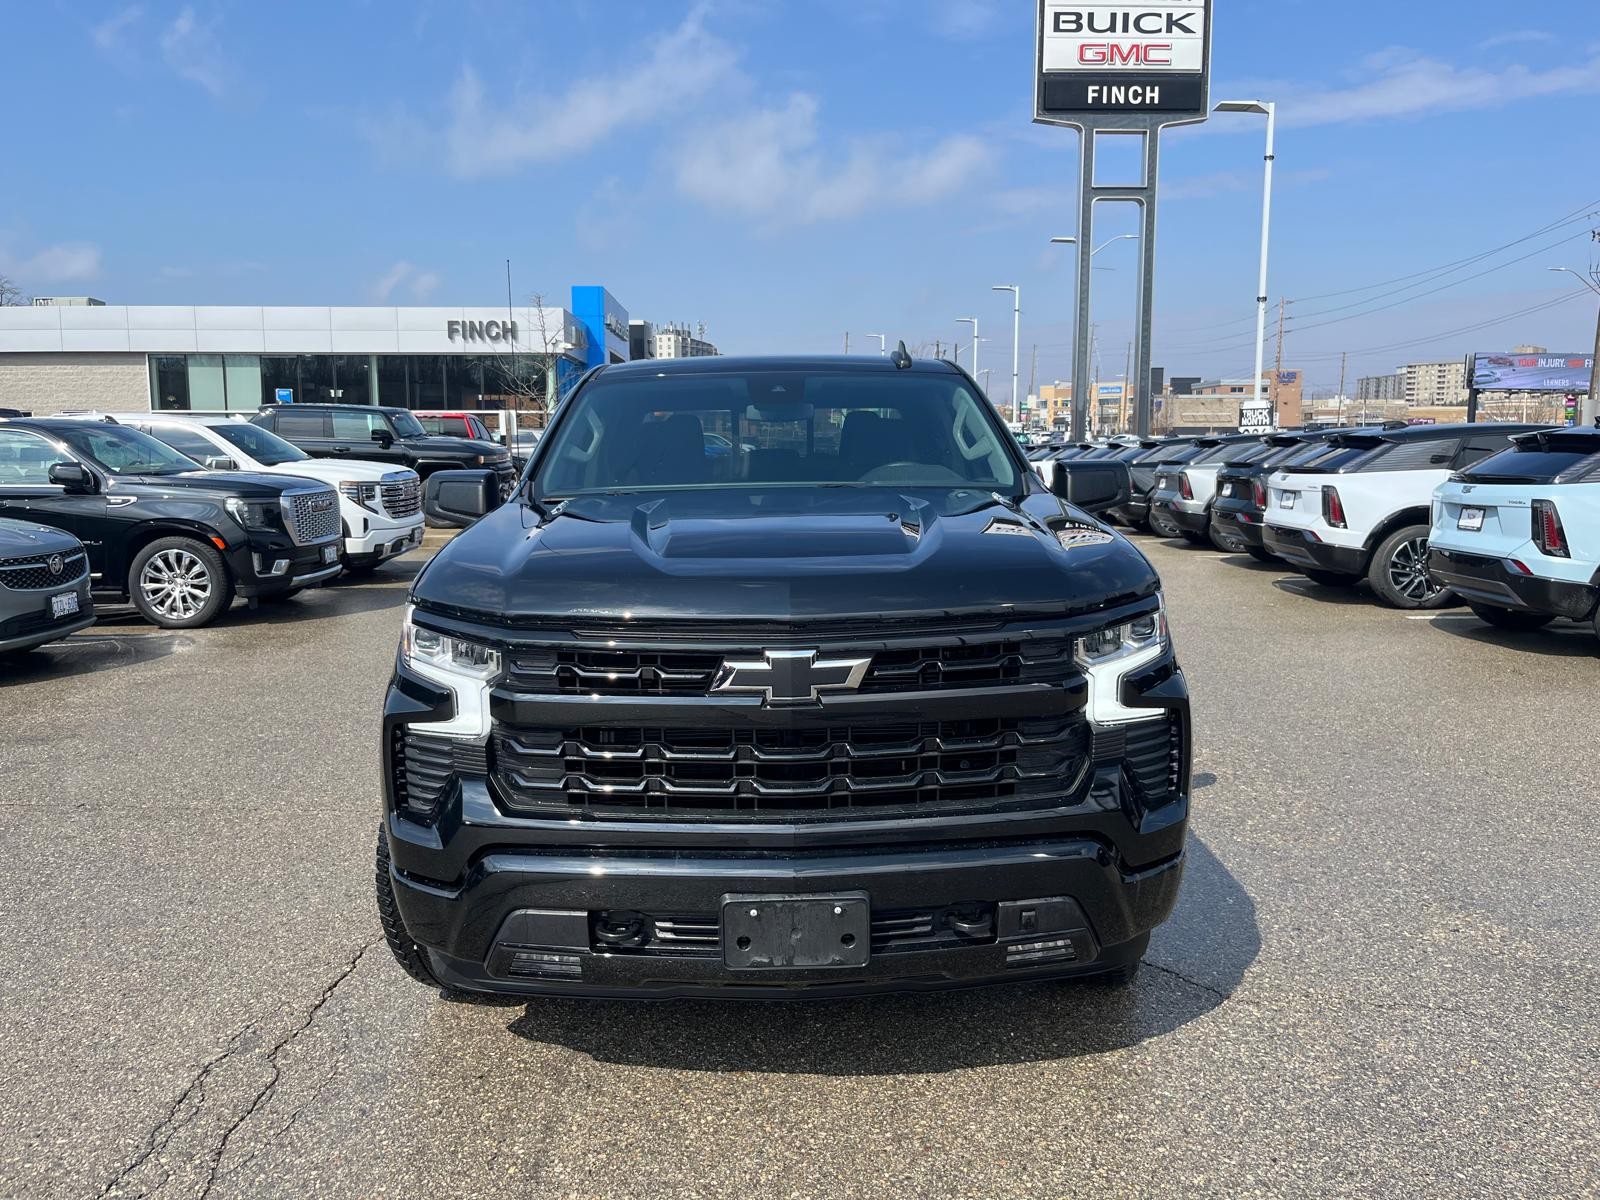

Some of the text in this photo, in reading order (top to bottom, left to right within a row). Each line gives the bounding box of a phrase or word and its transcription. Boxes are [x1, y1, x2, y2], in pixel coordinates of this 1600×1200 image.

[1053, 11, 1196, 34] BUICK
[1078, 42, 1172, 65] GMC
[1087, 85, 1160, 104] FINCH
[447, 320, 517, 342] FINCH
[1538, 358, 1566, 368] INJURY.
[1241, 417, 1270, 426] MONTH
[1242, 409, 1270, 418] TRUCK
